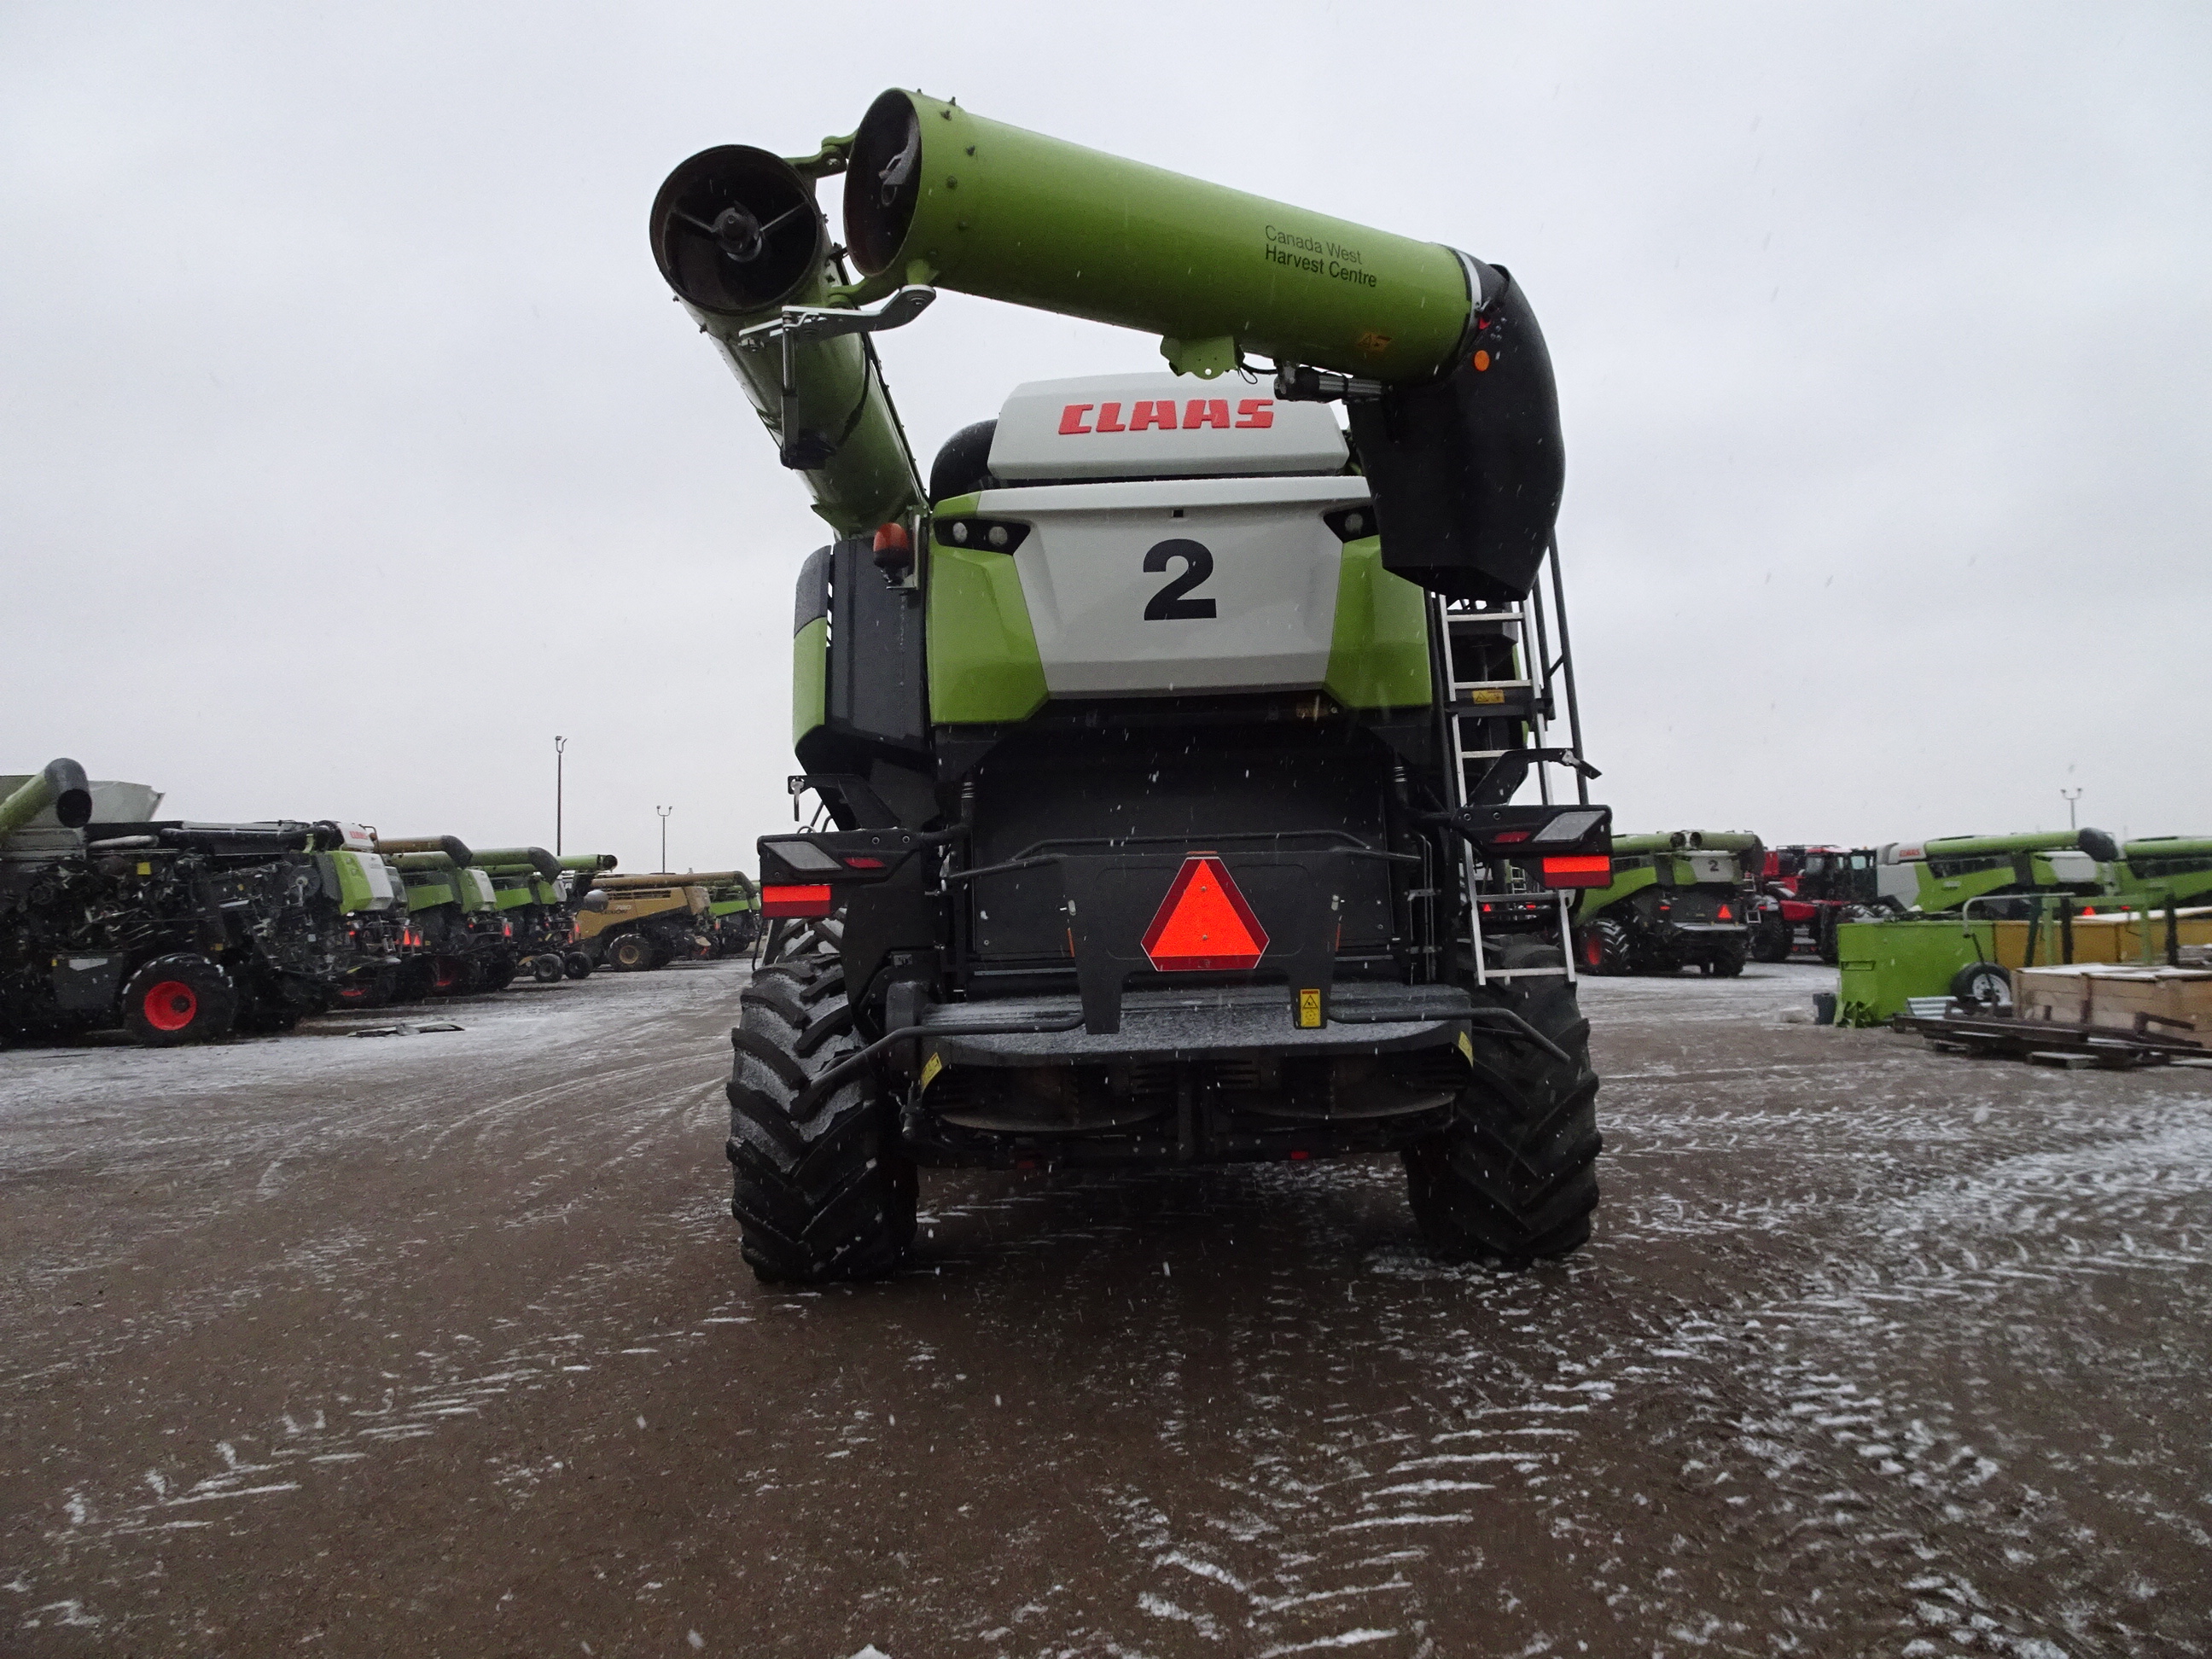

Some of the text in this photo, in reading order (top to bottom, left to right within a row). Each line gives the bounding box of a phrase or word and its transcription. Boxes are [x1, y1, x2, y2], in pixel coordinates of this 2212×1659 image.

[1265, 224, 1363, 265] Canada West
[1265, 243, 1377, 288] Harvest Centre
[1058, 399, 1274, 434] CLAAS
[1143, 538, 1217, 621] 2
[1708, 859, 1719, 871] 2
